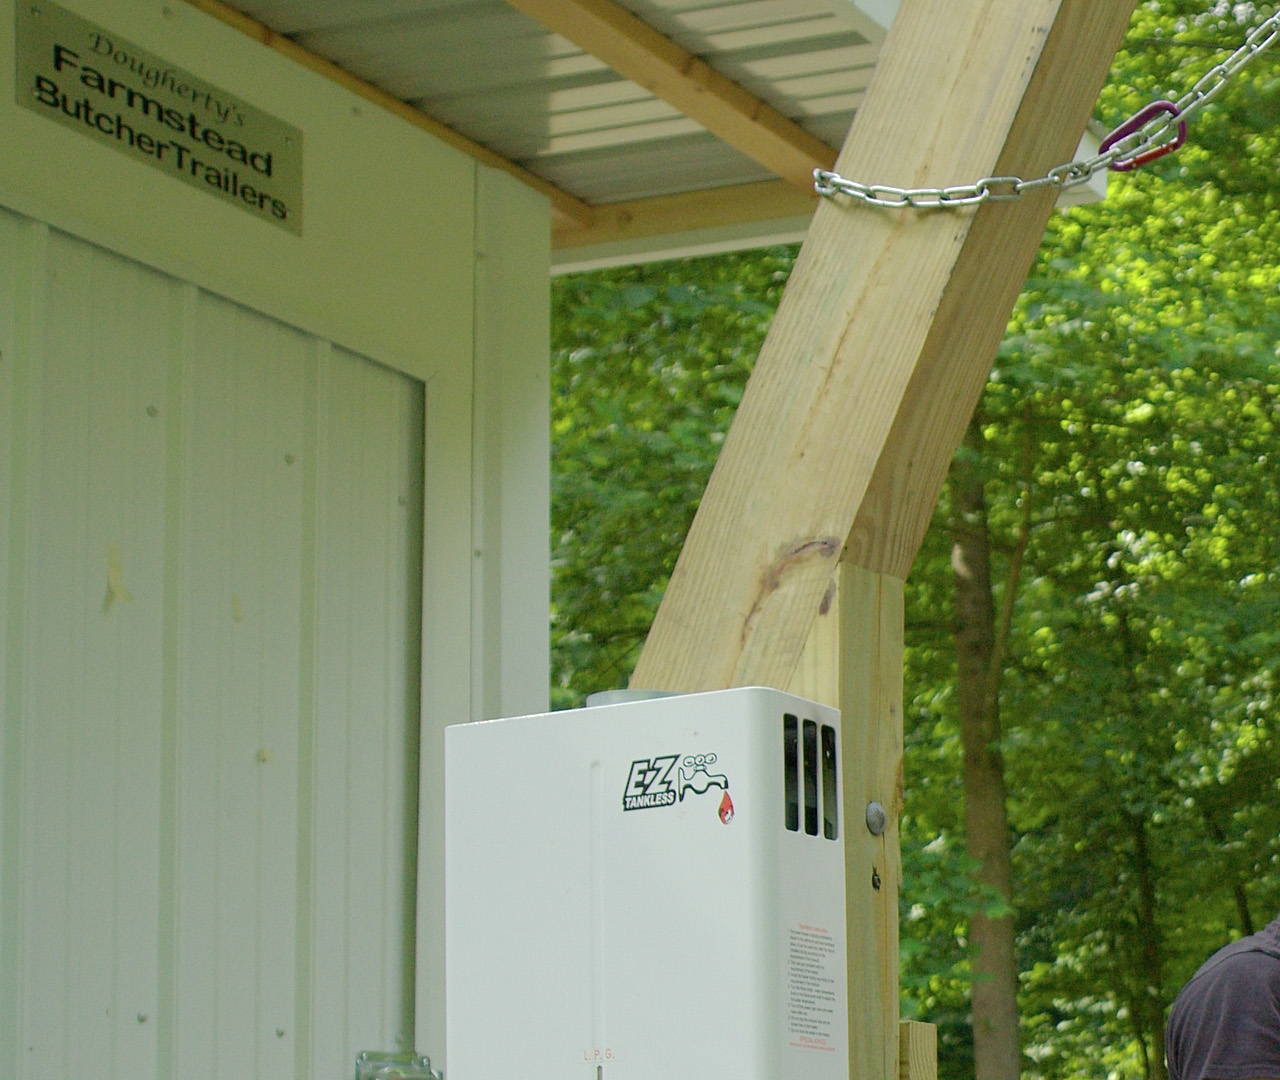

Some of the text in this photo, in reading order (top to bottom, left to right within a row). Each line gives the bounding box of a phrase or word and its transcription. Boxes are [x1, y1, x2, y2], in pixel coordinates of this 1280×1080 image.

[53, 43, 273, 177] Farmstead
[89, 31, 245, 127] Dougherty's
[35, 75, 288, 220] ButcherTrailers
[624, 792, 675, 809] TANKLESS
